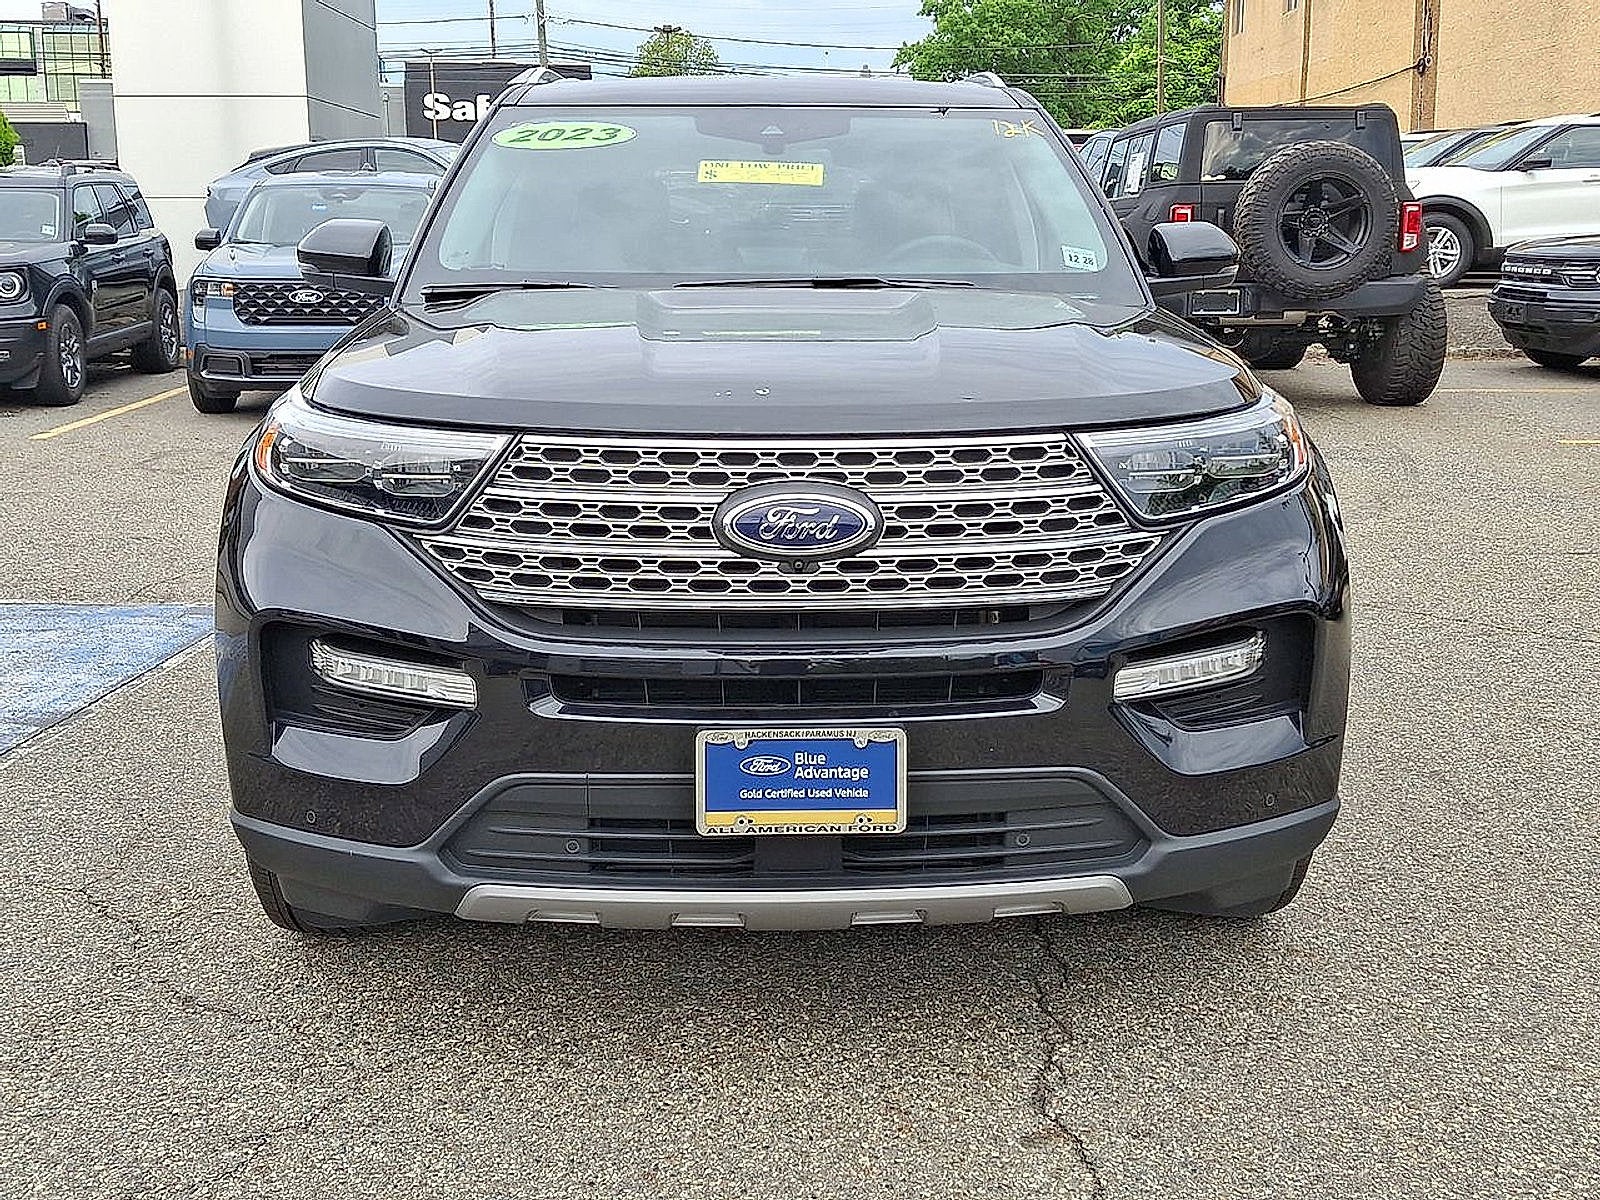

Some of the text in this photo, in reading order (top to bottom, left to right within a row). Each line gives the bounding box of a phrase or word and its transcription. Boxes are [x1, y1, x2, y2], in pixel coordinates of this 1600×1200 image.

[507, 127, 622, 143] 2023
[992, 119, 1045, 138] 12K
[758, 505, 841, 541] Ford
[748, 756, 782, 773] Ford
[794, 751, 827, 766] Blue
[794, 766, 869, 781] Advantage
[739, 787, 869, 799] Gold Certified Used Vehicle
[706, 824, 898, 835] ALL AMERICAN FORD
